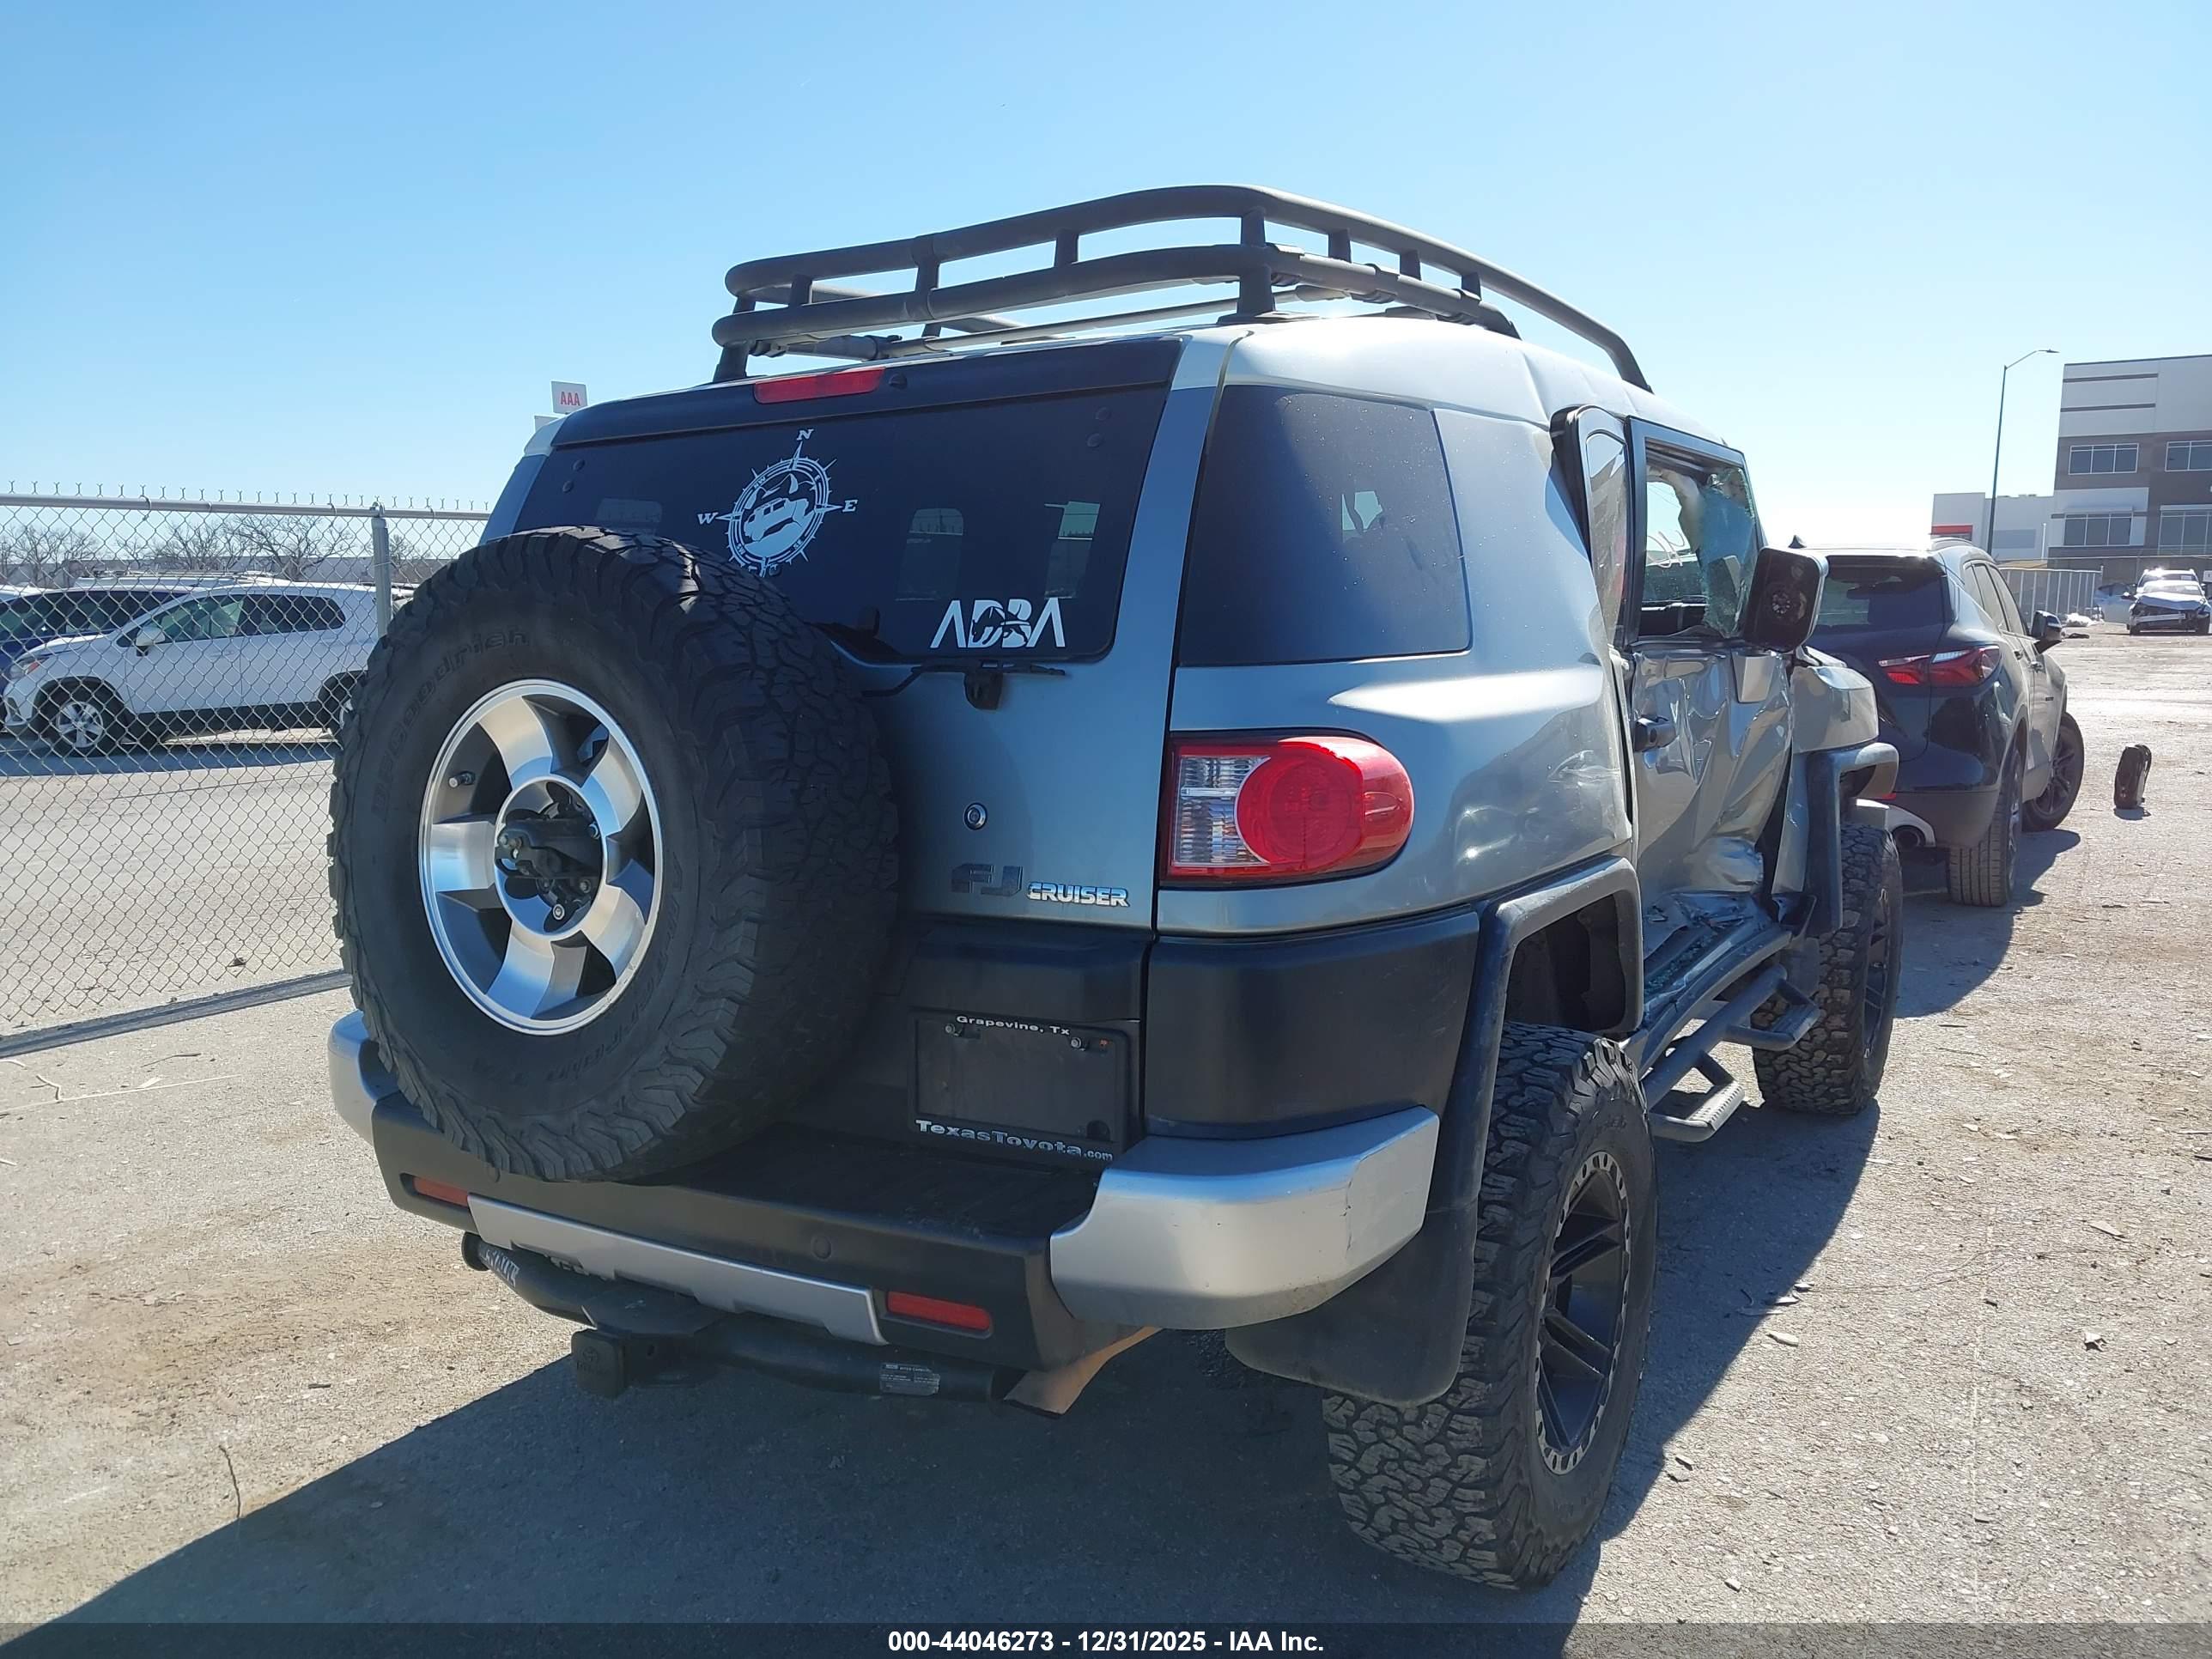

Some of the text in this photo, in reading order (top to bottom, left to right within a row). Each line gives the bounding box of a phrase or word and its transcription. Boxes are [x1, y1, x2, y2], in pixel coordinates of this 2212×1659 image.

[560, 391, 581, 406] AAA
[796, 428, 814, 441] N
[842, 499, 858, 513] E
[697, 512, 719, 525] W
[930, 597, 1066, 648] ADBA
[951, 863, 1130, 908] FJ CRUISER
[956, 1016, 1071, 1036] Grapevine, Tx
[915, 1119, 1113, 1161] TexasToyota.com
